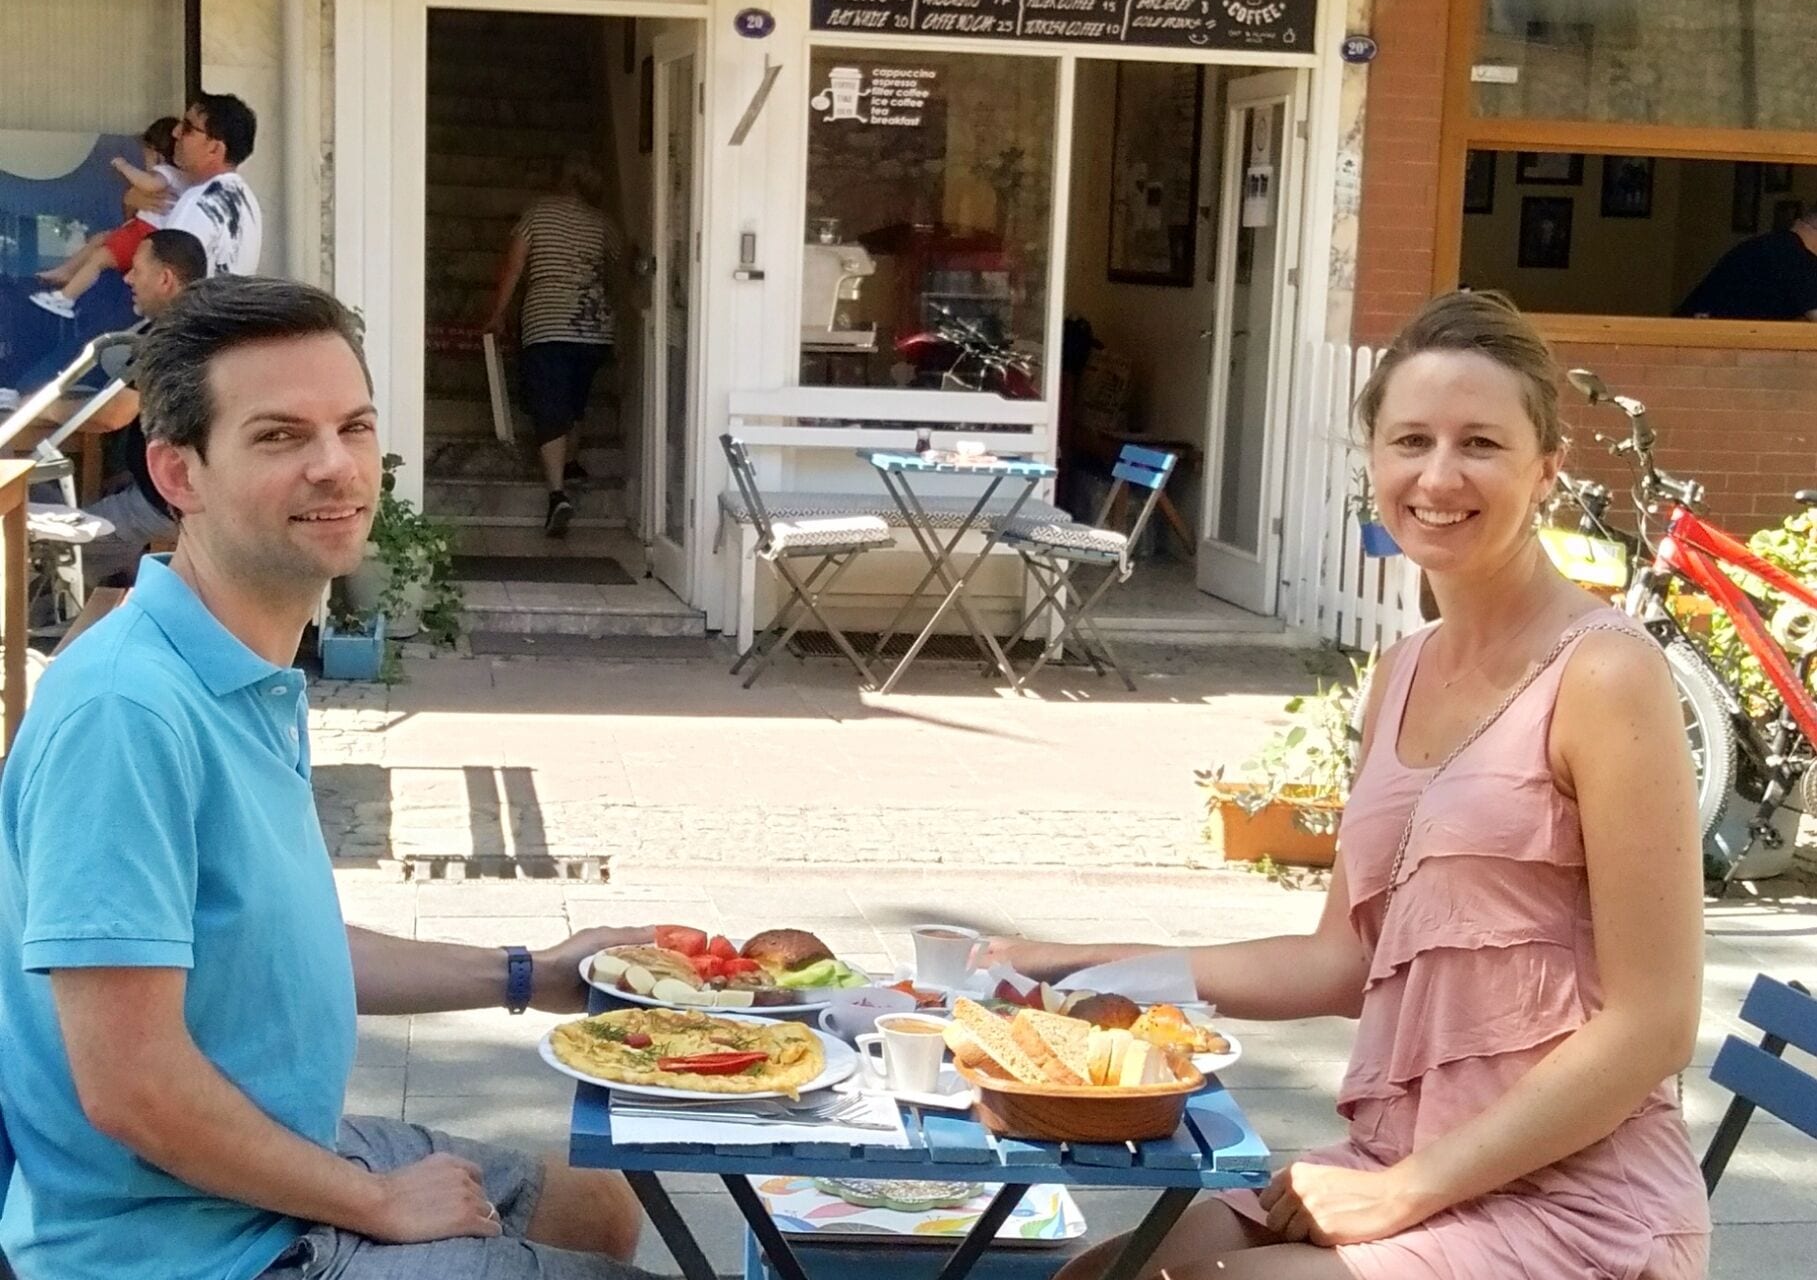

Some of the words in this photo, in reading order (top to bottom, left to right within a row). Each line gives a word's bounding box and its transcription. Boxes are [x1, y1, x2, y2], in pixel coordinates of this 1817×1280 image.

[1102, 0, 1117, 13] 15
[1227, 2, 1282, 26] COFFEE
[745, 15, 765, 29] 20
[894, 14, 909, 29] 20
[1065, 21, 1106, 37] COFFEE
[1106, 23, 1120, 35] 10
[872, 68, 937, 80] cappuccino
[871, 79, 918, 89] espresso
[871, 87, 895, 97] filter
[895, 88, 930, 99] coffee
[871, 98, 889, 107] ice
[889, 97, 925, 108] coffee
[870, 107, 890, 116] tea
[870, 116, 921, 127] breakfast
